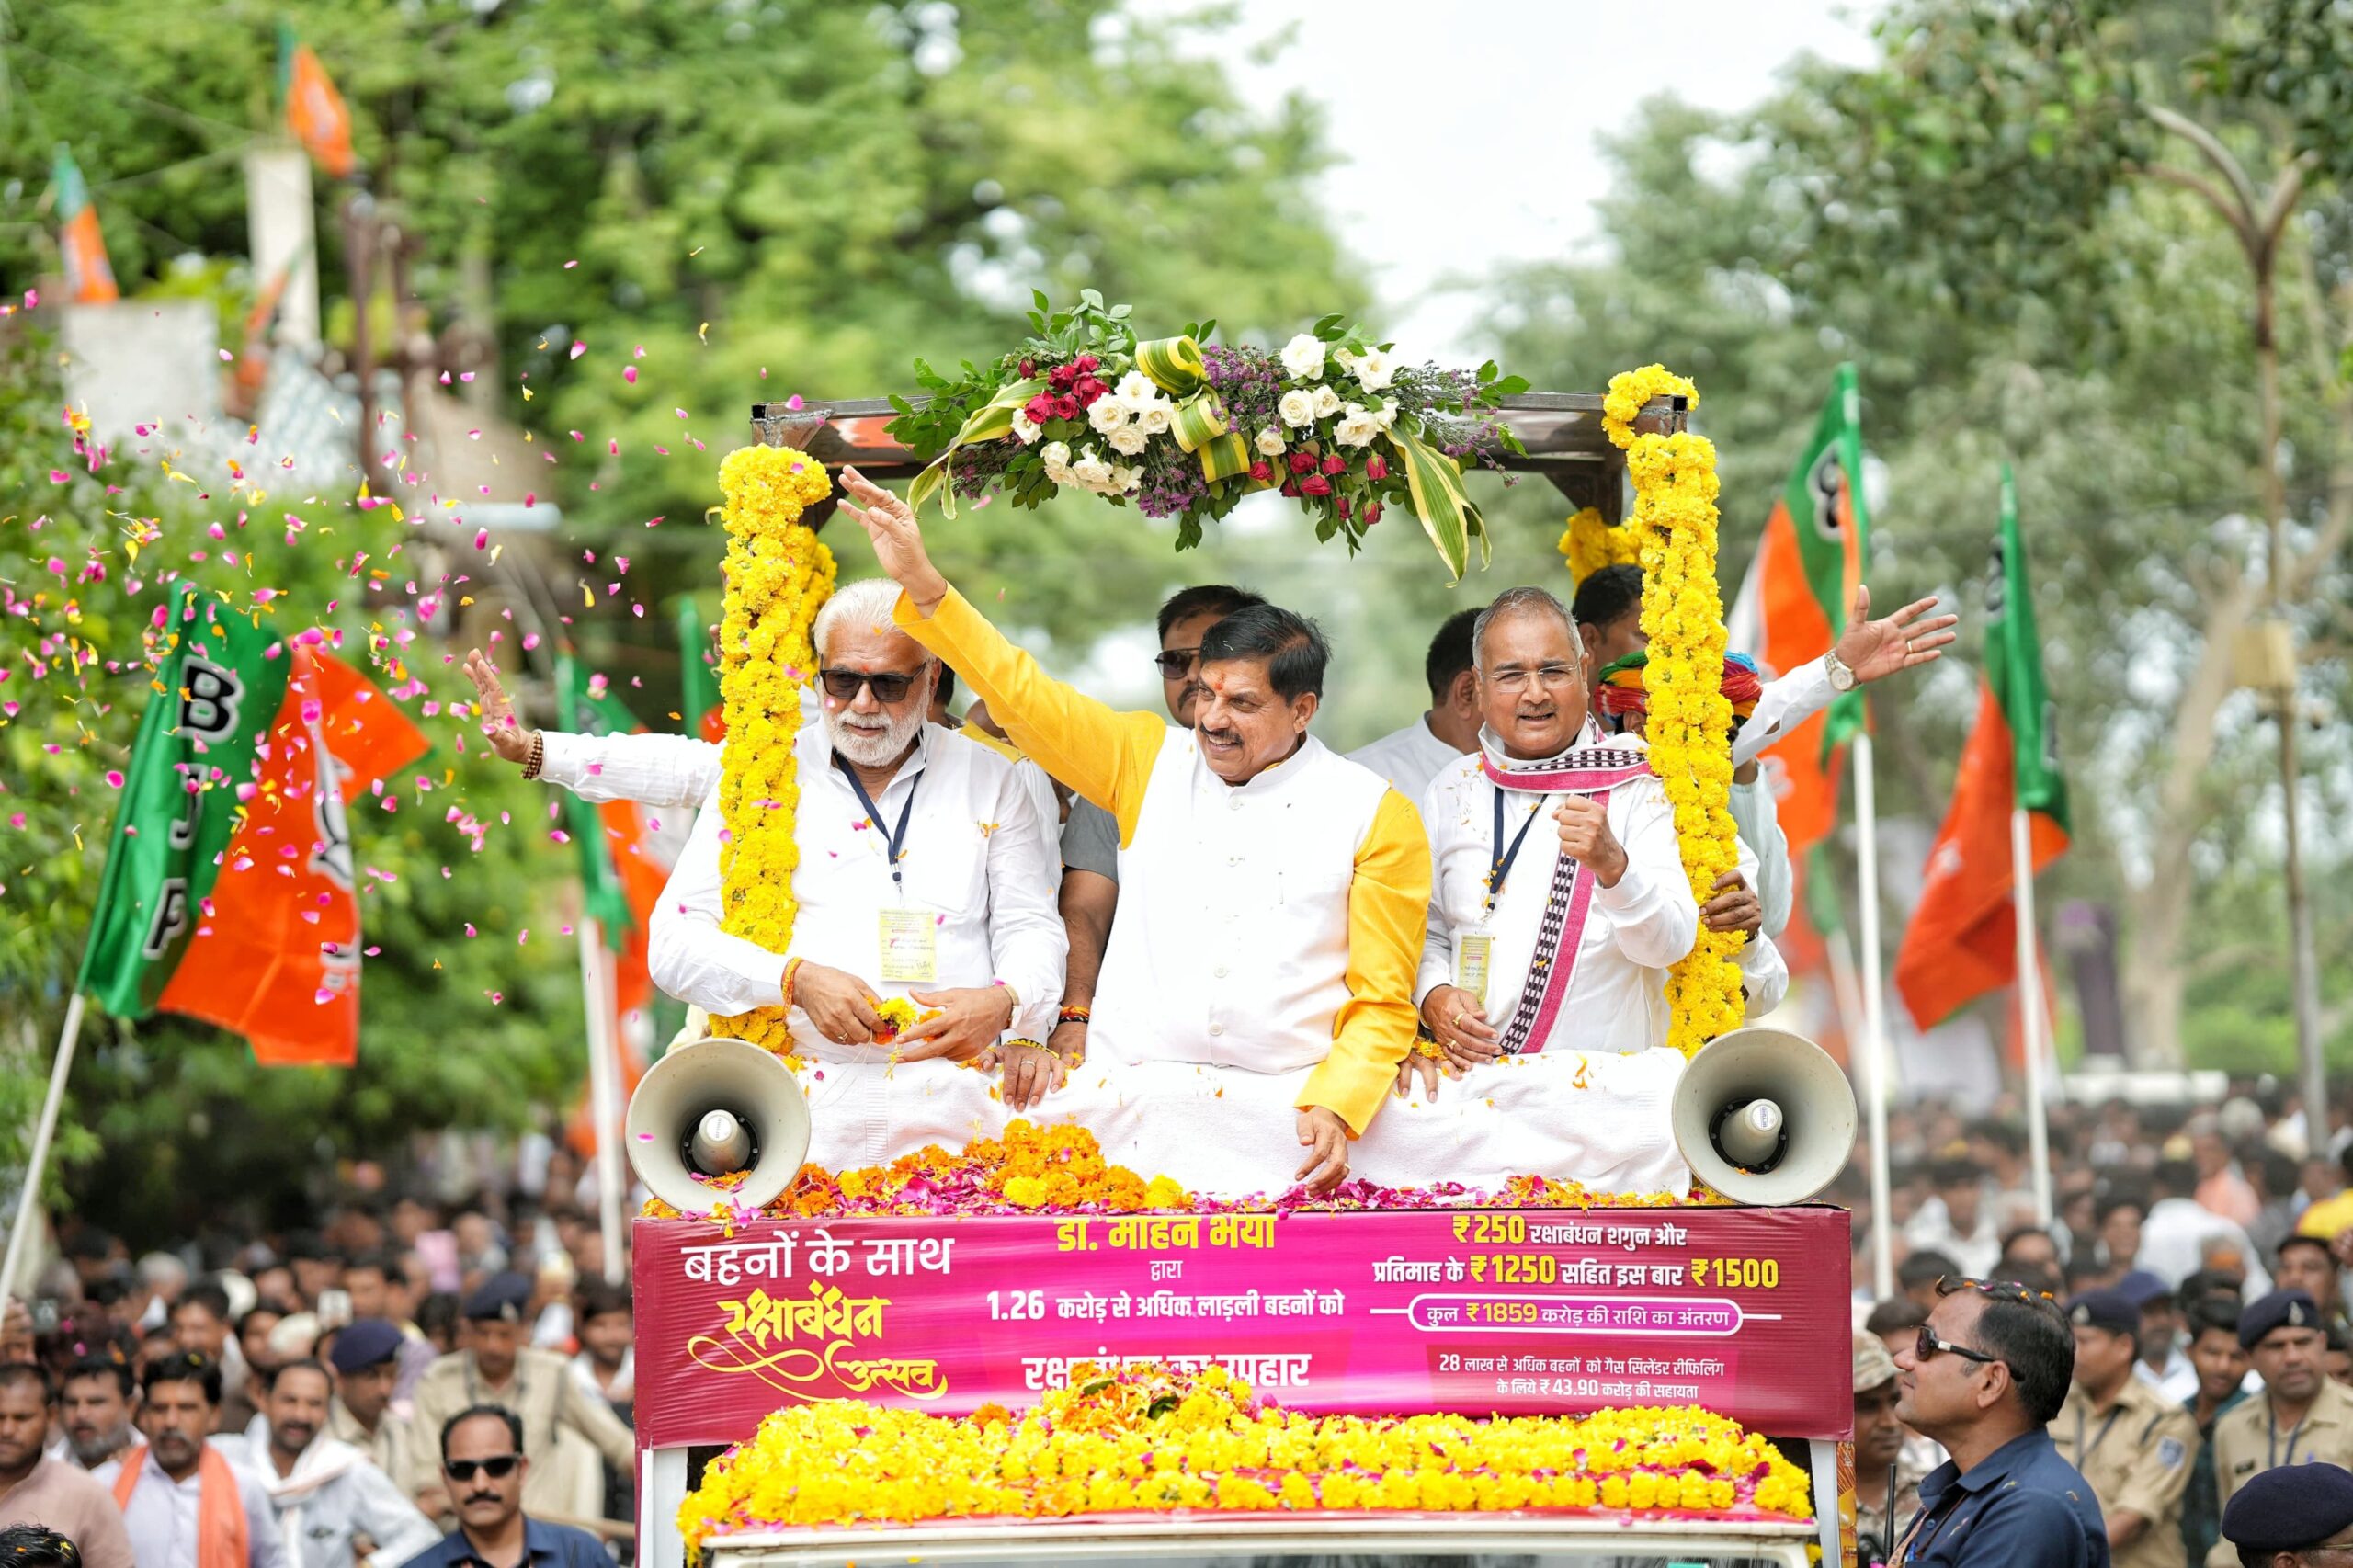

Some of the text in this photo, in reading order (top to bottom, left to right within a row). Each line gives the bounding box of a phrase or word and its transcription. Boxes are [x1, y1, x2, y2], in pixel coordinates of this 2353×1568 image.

[1529, 1222, 1603, 1244] रक्षाबंधन
[1608, 1226, 1652, 1251] शगुन
[1655, 1222, 1688, 1246] और
[681, 1229, 955, 1286] बहनों के साथ
[1150, 1260, 1183, 1282] द्वारा
[1372, 1256, 1442, 1283] प्रतिमाह
[1445, 1256, 1466, 1282] के
[1560, 1257, 1612, 1285] सहित
[1615, 1264, 1647, 1287] इस
[1650, 1265, 1684, 1286] बार
[986, 1289, 1345, 1324] 1.26 करोड़ से अधिक लाड़ली बहनों को
[1427, 1307, 1460, 1326] कुल
[1540, 1304, 1583, 1327] करोड़
[1586, 1304, 1609, 1324] की
[1612, 1305, 1647, 1324] राशि
[1651, 1311, 1674, 1324] का
[1677, 1307, 1730, 1326] अंतरण
[1439, 1354, 1725, 1376] 28 लाख से अधिक बहनों को गैस सिलेंडर रीफिलिंग
[1496, 1378, 1508, 1394] के
[1511, 1379, 1536, 1394] लिये
[1601, 1381, 1632, 1400] करोड़
[1635, 1381, 1651, 1397] की
[1653, 1384, 1699, 1399] सहायता
